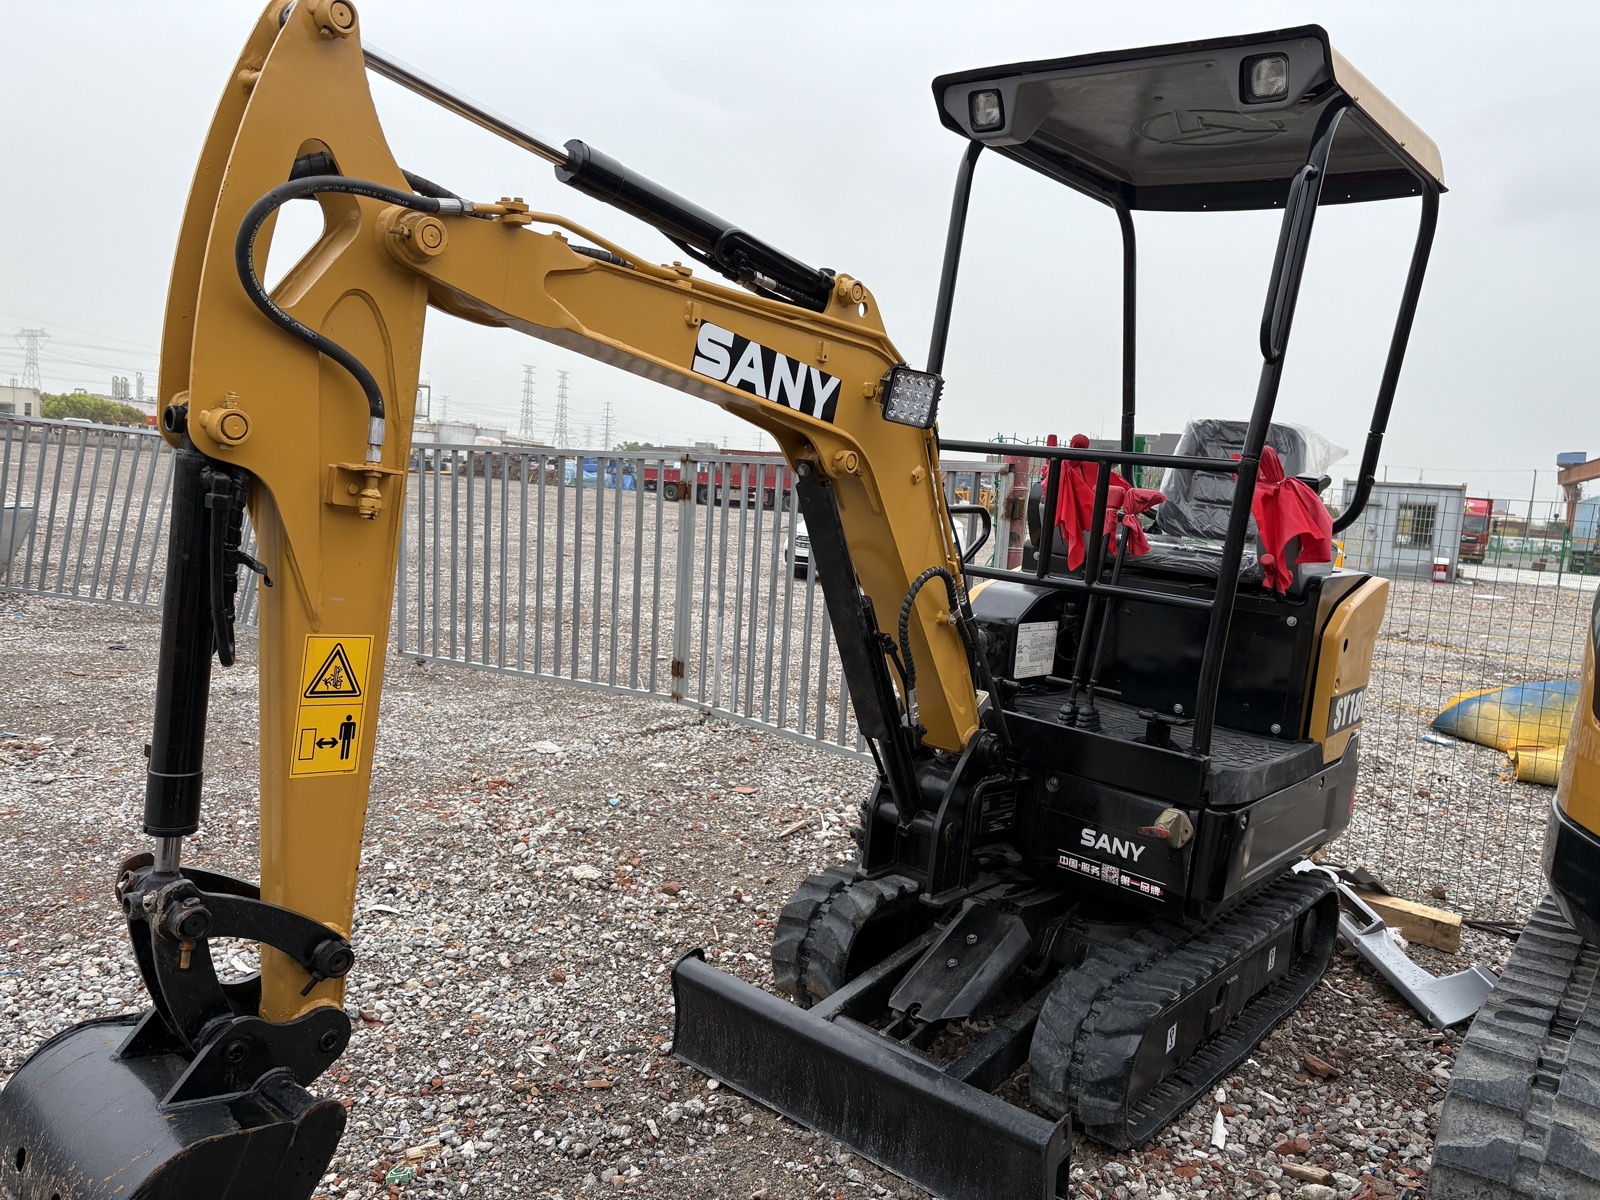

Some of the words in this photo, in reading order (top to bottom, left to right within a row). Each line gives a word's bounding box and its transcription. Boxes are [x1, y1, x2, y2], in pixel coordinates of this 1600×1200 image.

[259, 290, 269, 302] DIN
[267, 300, 290, 322] GERMAN
[692, 322, 841, 420] SANY
[1080, 827, 1146, 862] SANY
[1120, 874, 1162, 897] 第一品牌
